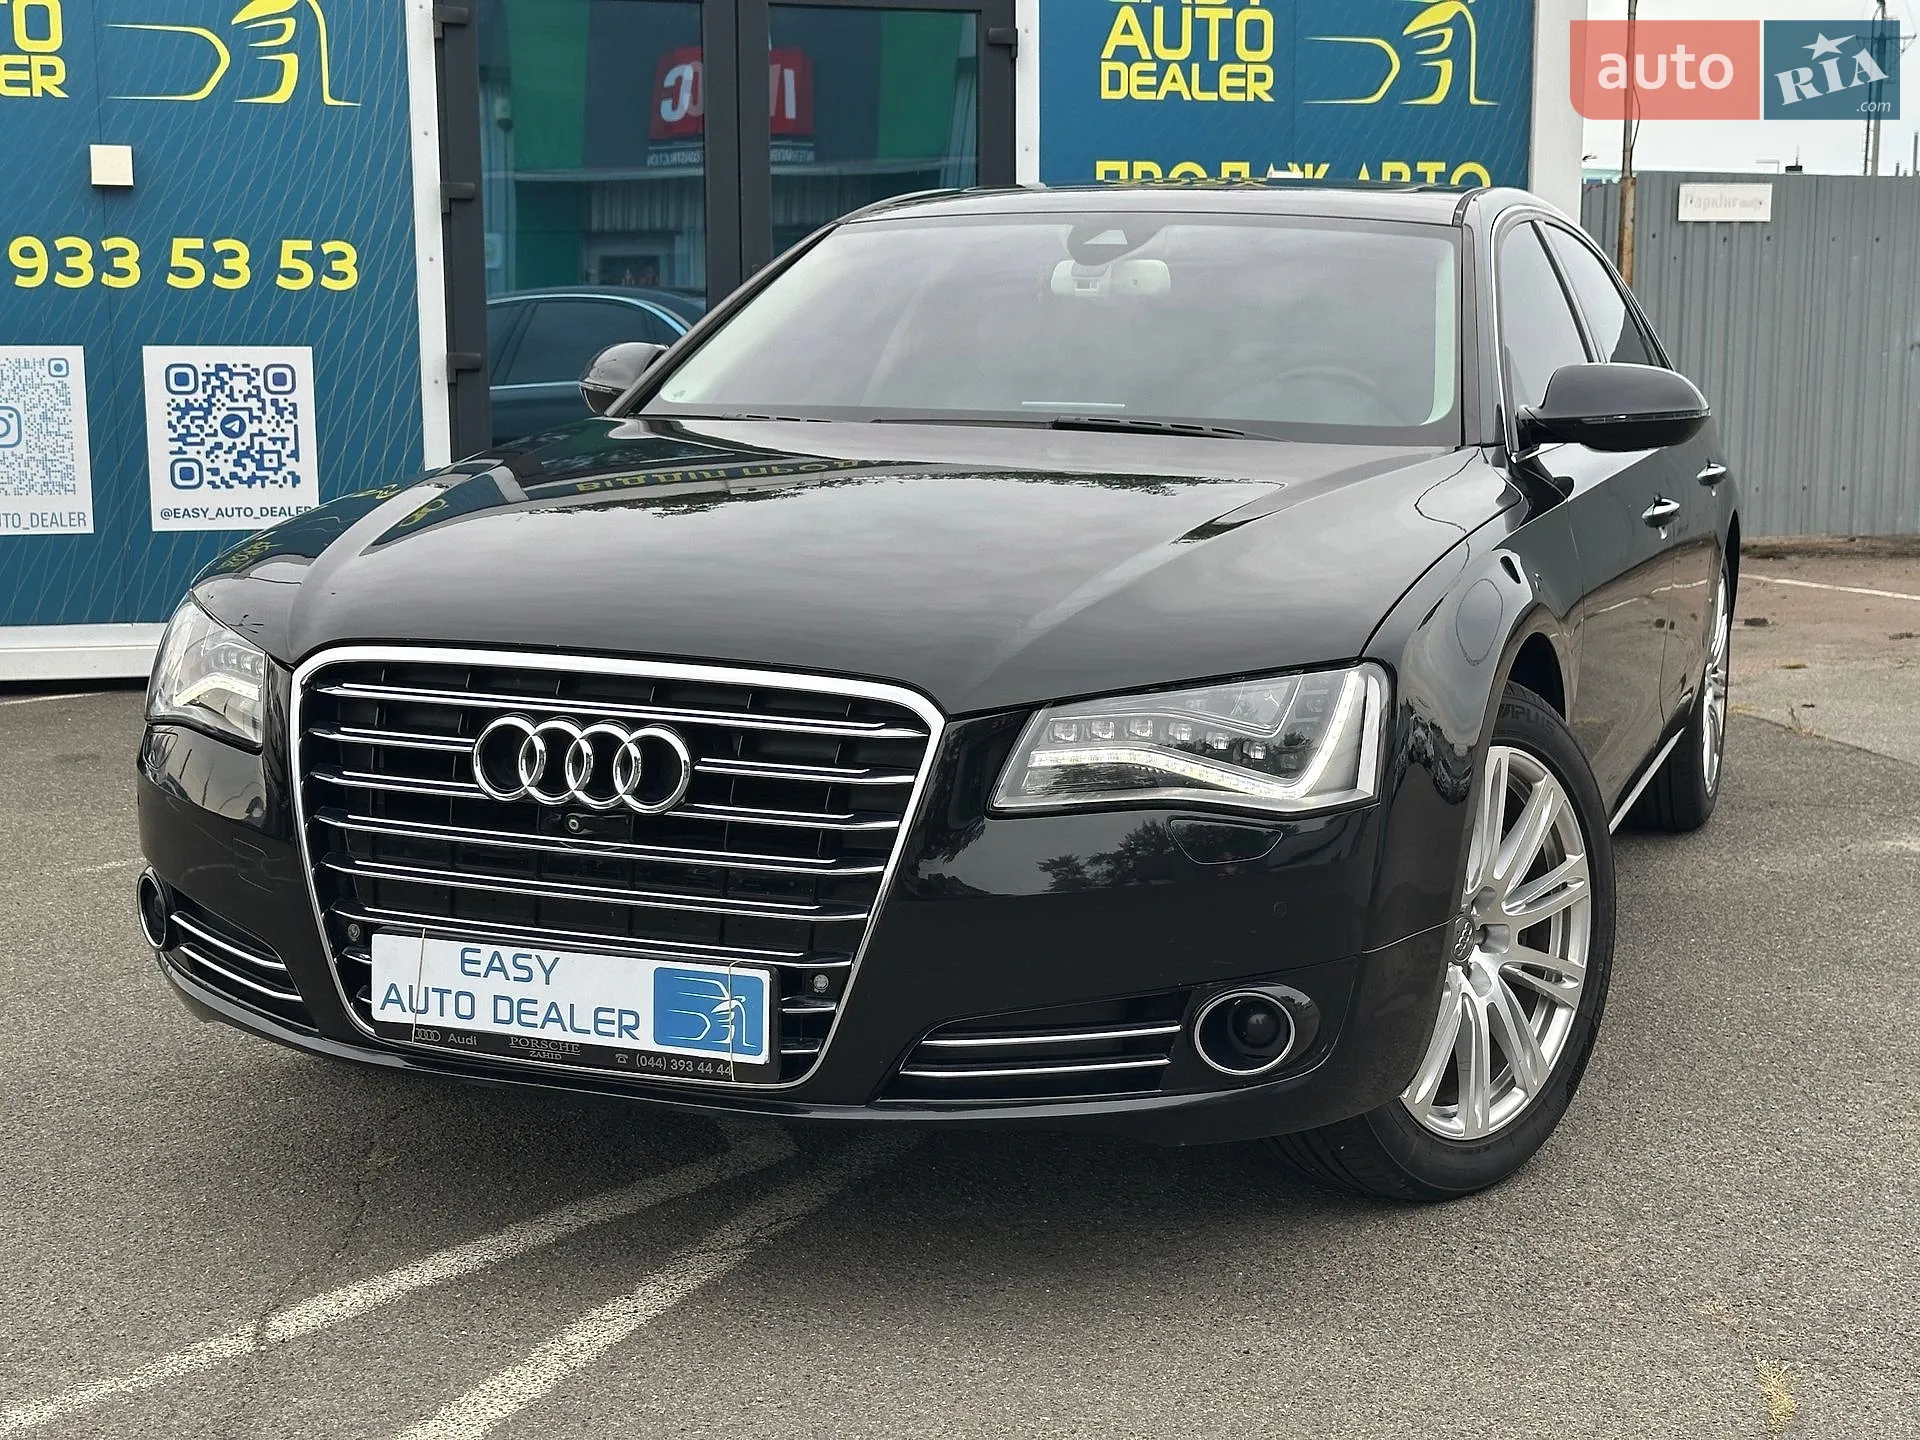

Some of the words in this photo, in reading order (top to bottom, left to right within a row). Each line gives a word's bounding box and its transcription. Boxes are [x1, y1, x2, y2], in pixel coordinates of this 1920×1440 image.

[1100, 5, 1274, 62] AUTO
[1100, 61, 1275, 102] DEALER
[7, 235, 142, 289] 933
[166, 237, 251, 290] 53
[275, 239, 359, 291] 53
[0, 511, 88, 530] TO_DEALER
[459, 946, 561, 986] EASY
[379, 982, 476, 1021] AUTO
[492, 994, 641, 1041] DEALER
[447, 1032, 478, 1047] Audi
[509, 1035, 581, 1054] PORSCHE
[528, 1049, 563, 1061] ZAHID
[636, 1052, 668, 1071] (044)
[669, 1059, 695, 1073] 393
[696, 1061, 714, 1075] 44
[716, 1063, 732, 1076] 44
